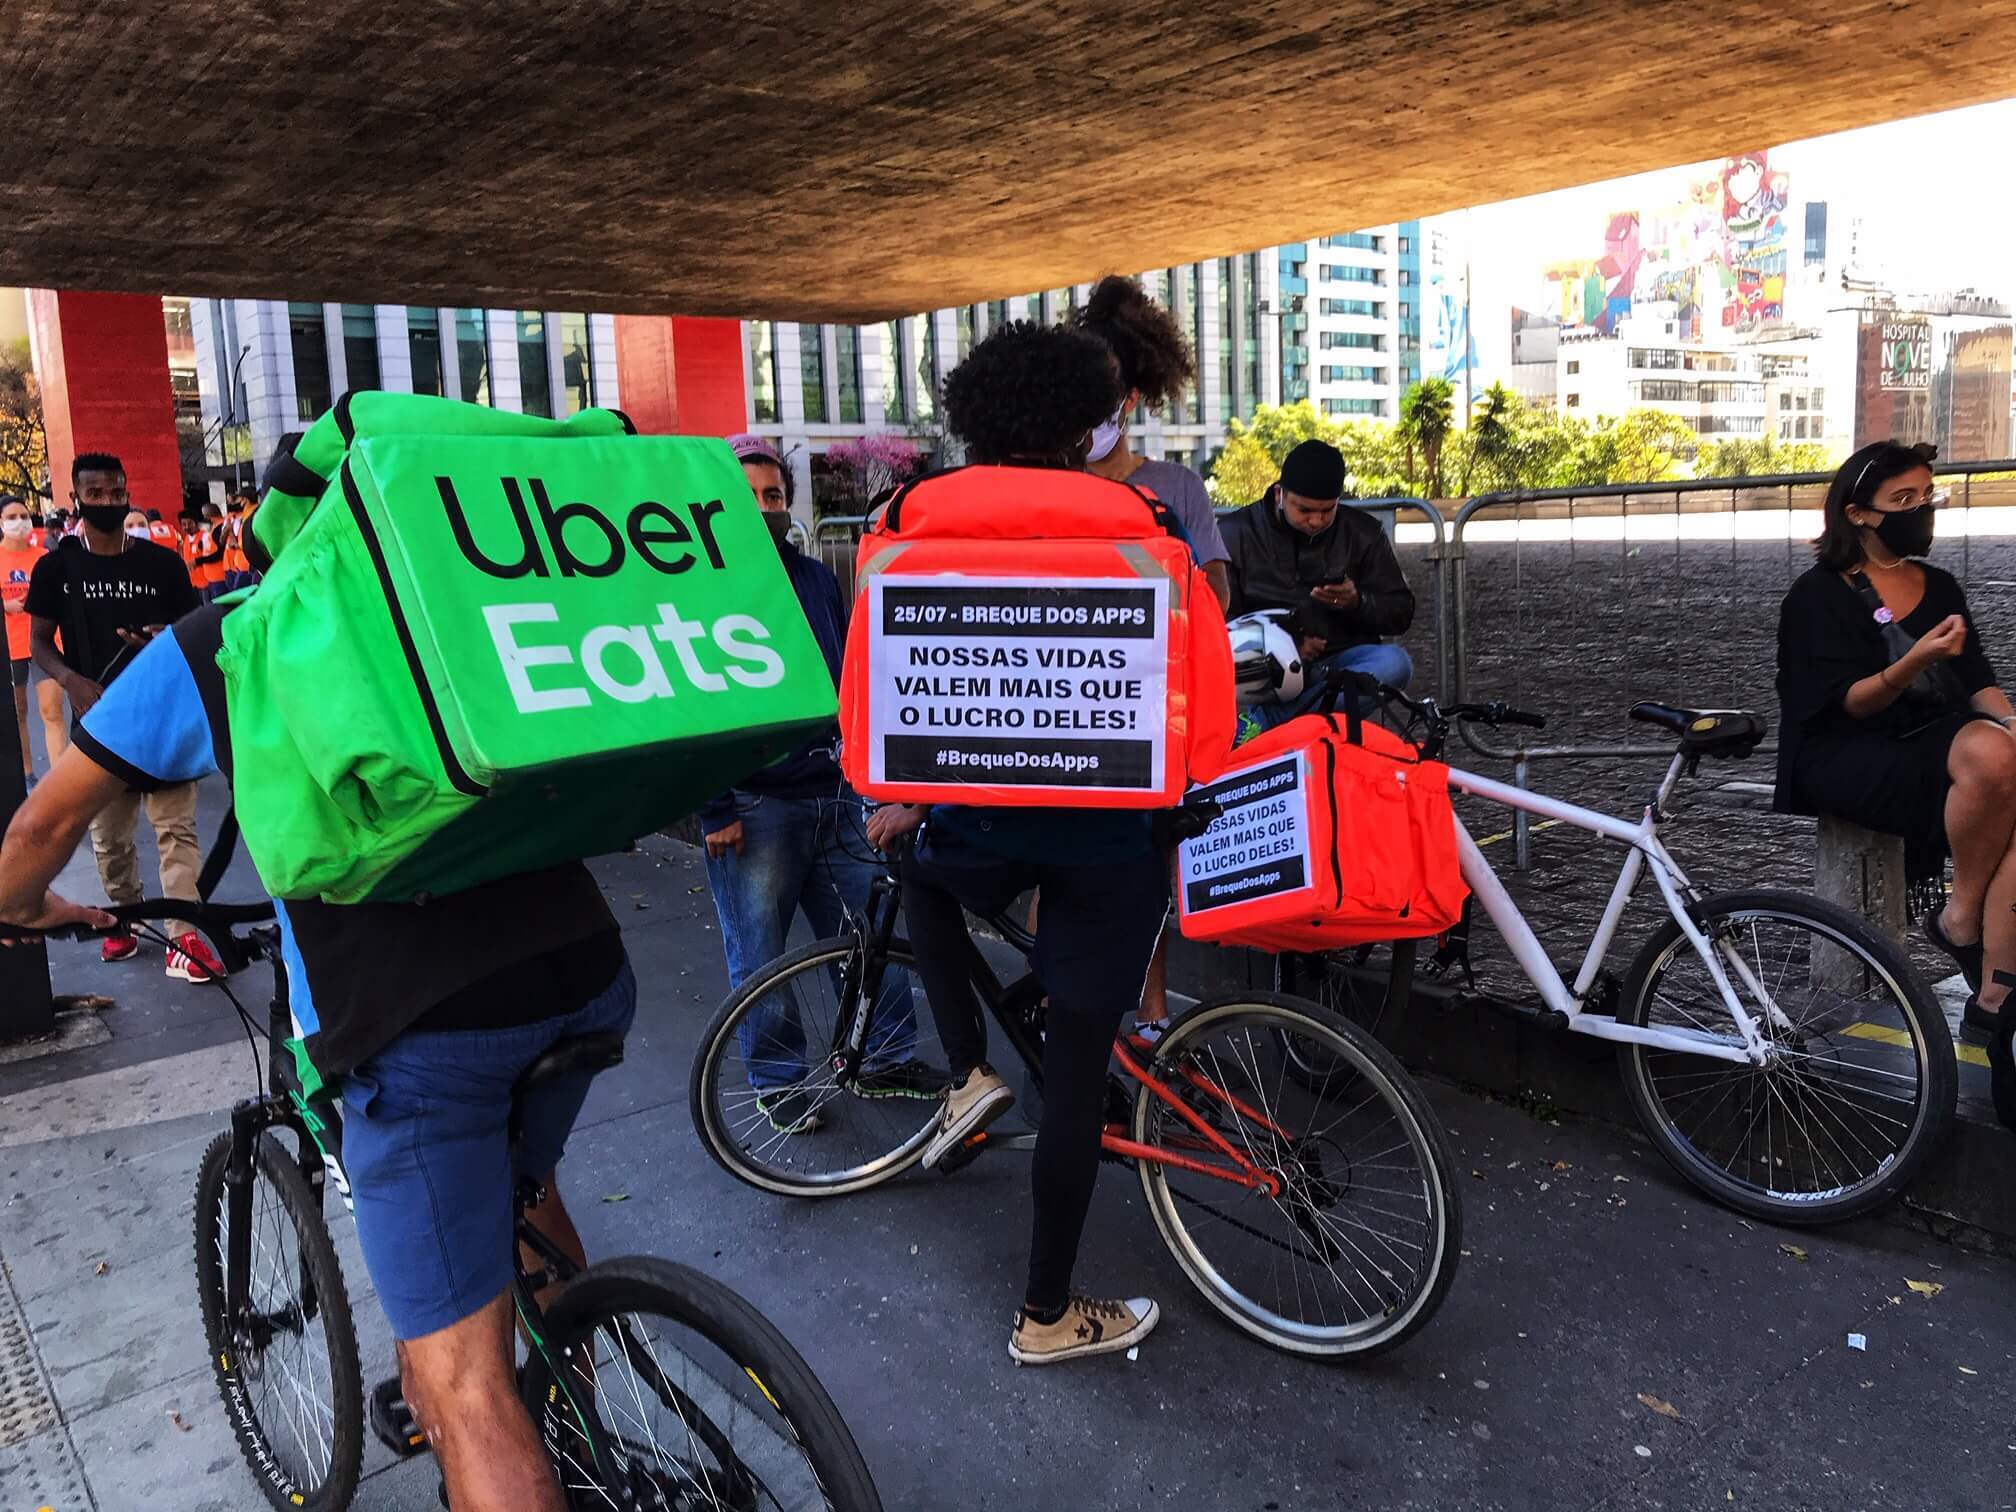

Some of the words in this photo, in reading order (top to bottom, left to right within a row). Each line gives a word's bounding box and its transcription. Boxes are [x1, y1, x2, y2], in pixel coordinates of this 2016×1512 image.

[1882, 324, 1930, 341] HOSPITAL
[1881, 371, 1895, 386] DE
[1903, 371, 1929, 386] JULHO
[434, 476, 726, 579] Uber
[63, 580, 113, 594] Clvin
[118, 580, 157, 596] Klein
[894, 606, 947, 624] 25/07
[962, 607, 1041, 625] BREQUE
[1046, 607, 1088, 624] DOS
[1092, 608, 1146, 625] APPS
[481, 602, 785, 714] Eats
[909, 646, 1028, 668] NOSSAS
[1036, 648, 1127, 669] VIDAS
[894, 676, 992, 698] VALEM
[999, 678, 1072, 699] MAIS
[1080, 679, 1142, 702] QUE
[899, 707, 920, 727] O
[928, 707, 1025, 729] LUCRO
[1033, 709, 1137, 730] DELES!
[936, 750, 1099, 772] #BrequeDosApps
[1249, 779, 1269, 795] DOS
[1269, 771, 1294, 789] APPS
[1205, 812, 1245, 835] SSAS
[1247, 800, 1286, 822] VIDAS
[1189, 835, 1230, 857] VALEM
[1234, 826, 1265, 846] MAIS
[1268, 817, 1295, 837] QUE
[1192, 863, 1202, 875] O
[1205, 851, 1246, 872] LUCRO
[1249, 837, 1295, 861] DELES!
[1209, 871, 1280, 896] #BrequeDosApps
